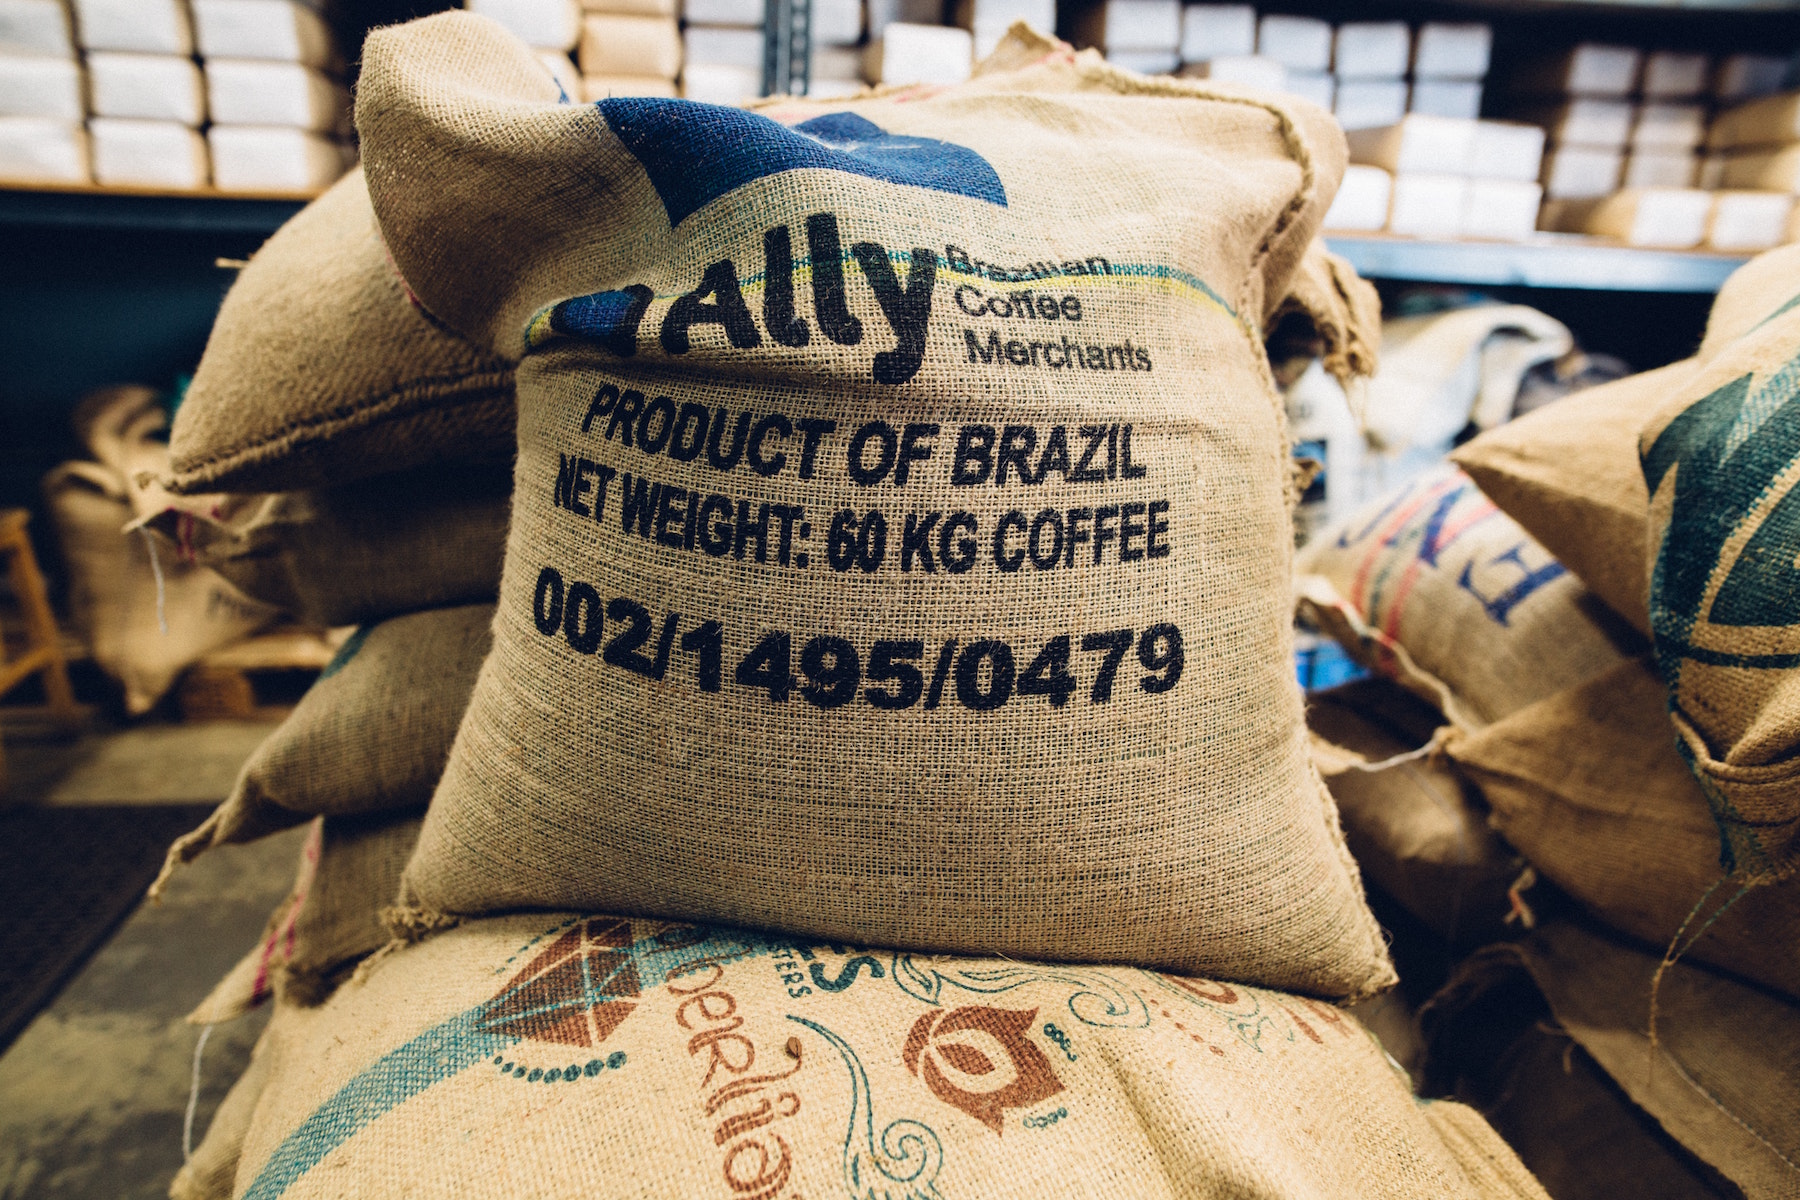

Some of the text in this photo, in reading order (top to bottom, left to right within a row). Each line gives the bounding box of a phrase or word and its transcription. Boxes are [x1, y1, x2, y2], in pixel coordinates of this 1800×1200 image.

[660, 212, 938, 386] Ally
[955, 284, 1083, 321] Coffee
[964, 328, 1153, 371] Merchants
[582, 384, 1147, 487] PRODUCT OF BRAZIL
[554, 452, 1172, 575] NET WEIGHT: 60 KG COFFEE
[533, 566, 1185, 710] 002/1495/0479
